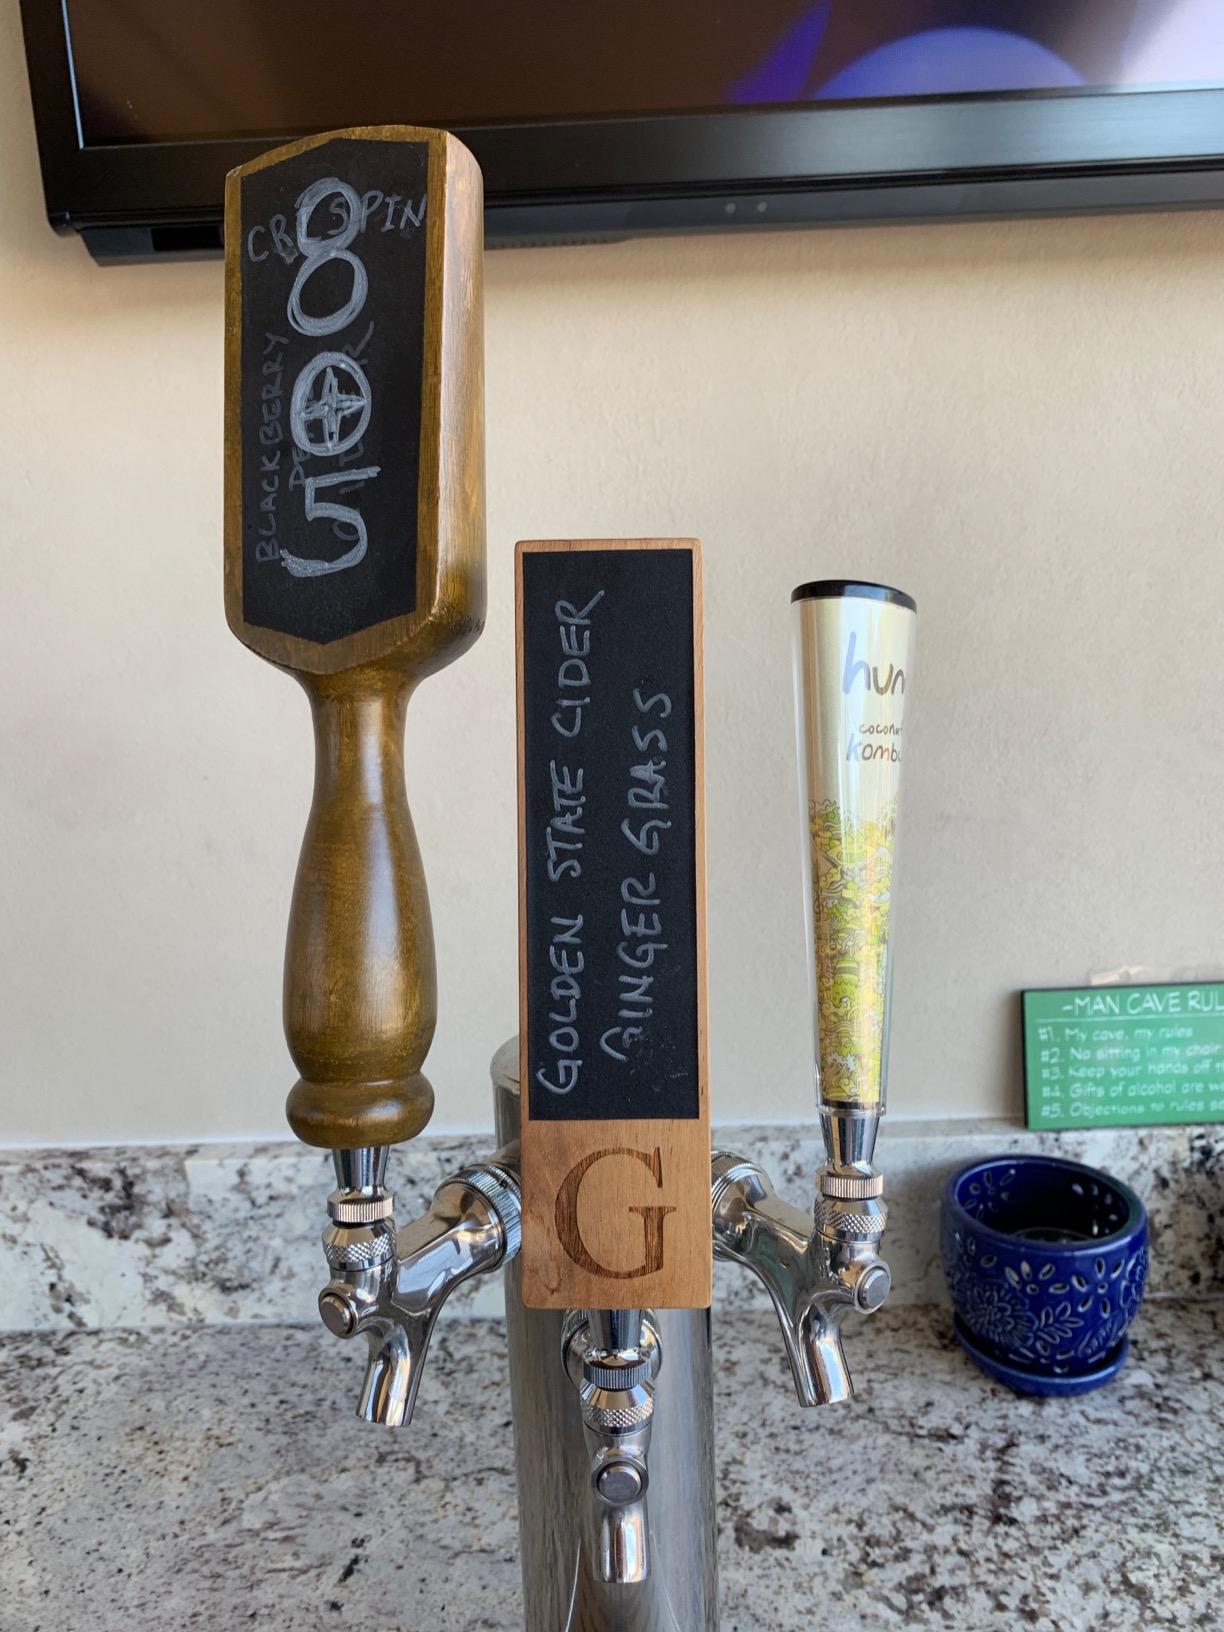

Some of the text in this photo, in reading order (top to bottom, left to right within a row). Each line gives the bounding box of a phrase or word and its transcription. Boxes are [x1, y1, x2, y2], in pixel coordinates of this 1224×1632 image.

[248, 190, 427, 264] CRSPIN
[536, 591, 605, 1095] GOLDEN STATE CIDER
[600, 689, 672, 1061] GINGER GRASS
[1127, 992, 1181, 1014] CAVE
[1065, 1028, 1085, 1043] My
[1135, 1028, 1152, 1040] my
[1159, 1025, 1193, 1038] rules
[1070, 1048, 1090, 1060] No
[1096, 1045, 1140, 1062] sitting
[1147, 1046, 1157, 1057] in
[1162, 1046, 1181, 1059] my
[1069, 1065, 1105, 1080] Keep
[1110, 1066, 1141, 1079] your
[1148, 1061, 1188, 1075] hands
[1193, 1060, 1214, 1074] off
[1070, 1083, 1105, 1098] Gifts
[1110, 1081, 1126, 1096] of
[1128, 1081, 1176, 1096] alcohol
[1182, 1082, 1204, 1094] are
[1070, 1103, 1144, 1119] Objections
[1151, 1101, 1164, 1112] to
[1170, 1099, 1204, 1112] rules
[555, 1147, 677, 1279] G
